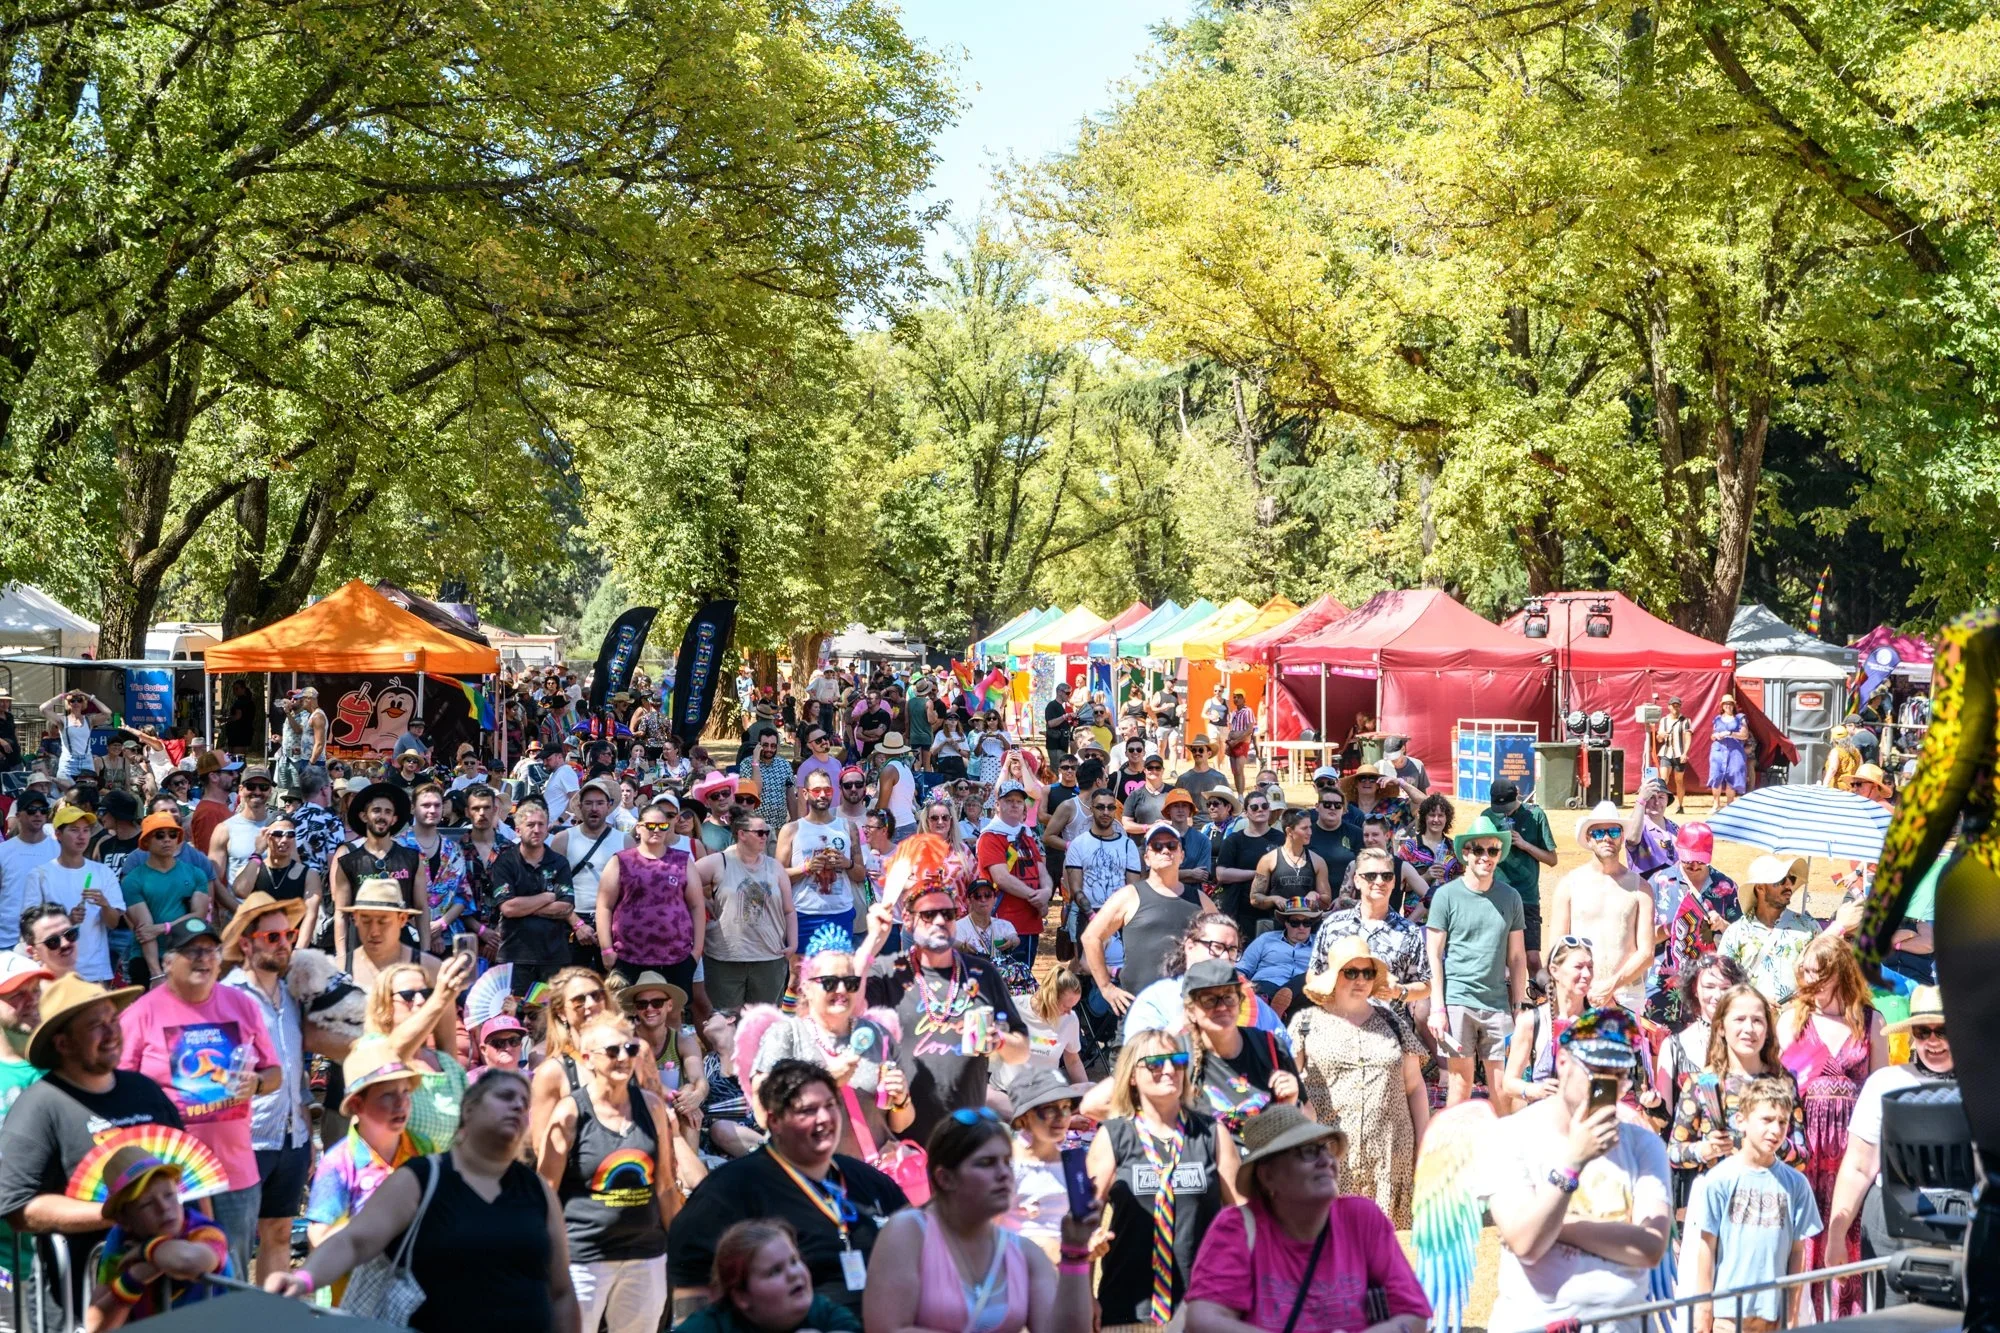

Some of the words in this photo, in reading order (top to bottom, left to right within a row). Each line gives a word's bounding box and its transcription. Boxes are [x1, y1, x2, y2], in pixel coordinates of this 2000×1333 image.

[130, 683, 143, 692] The
[144, 683, 169, 692] Coolest
[138, 692, 160, 701] Drinks
[144, 701, 162, 710] Town
[186, 1097, 244, 1117] VOLUNTE
